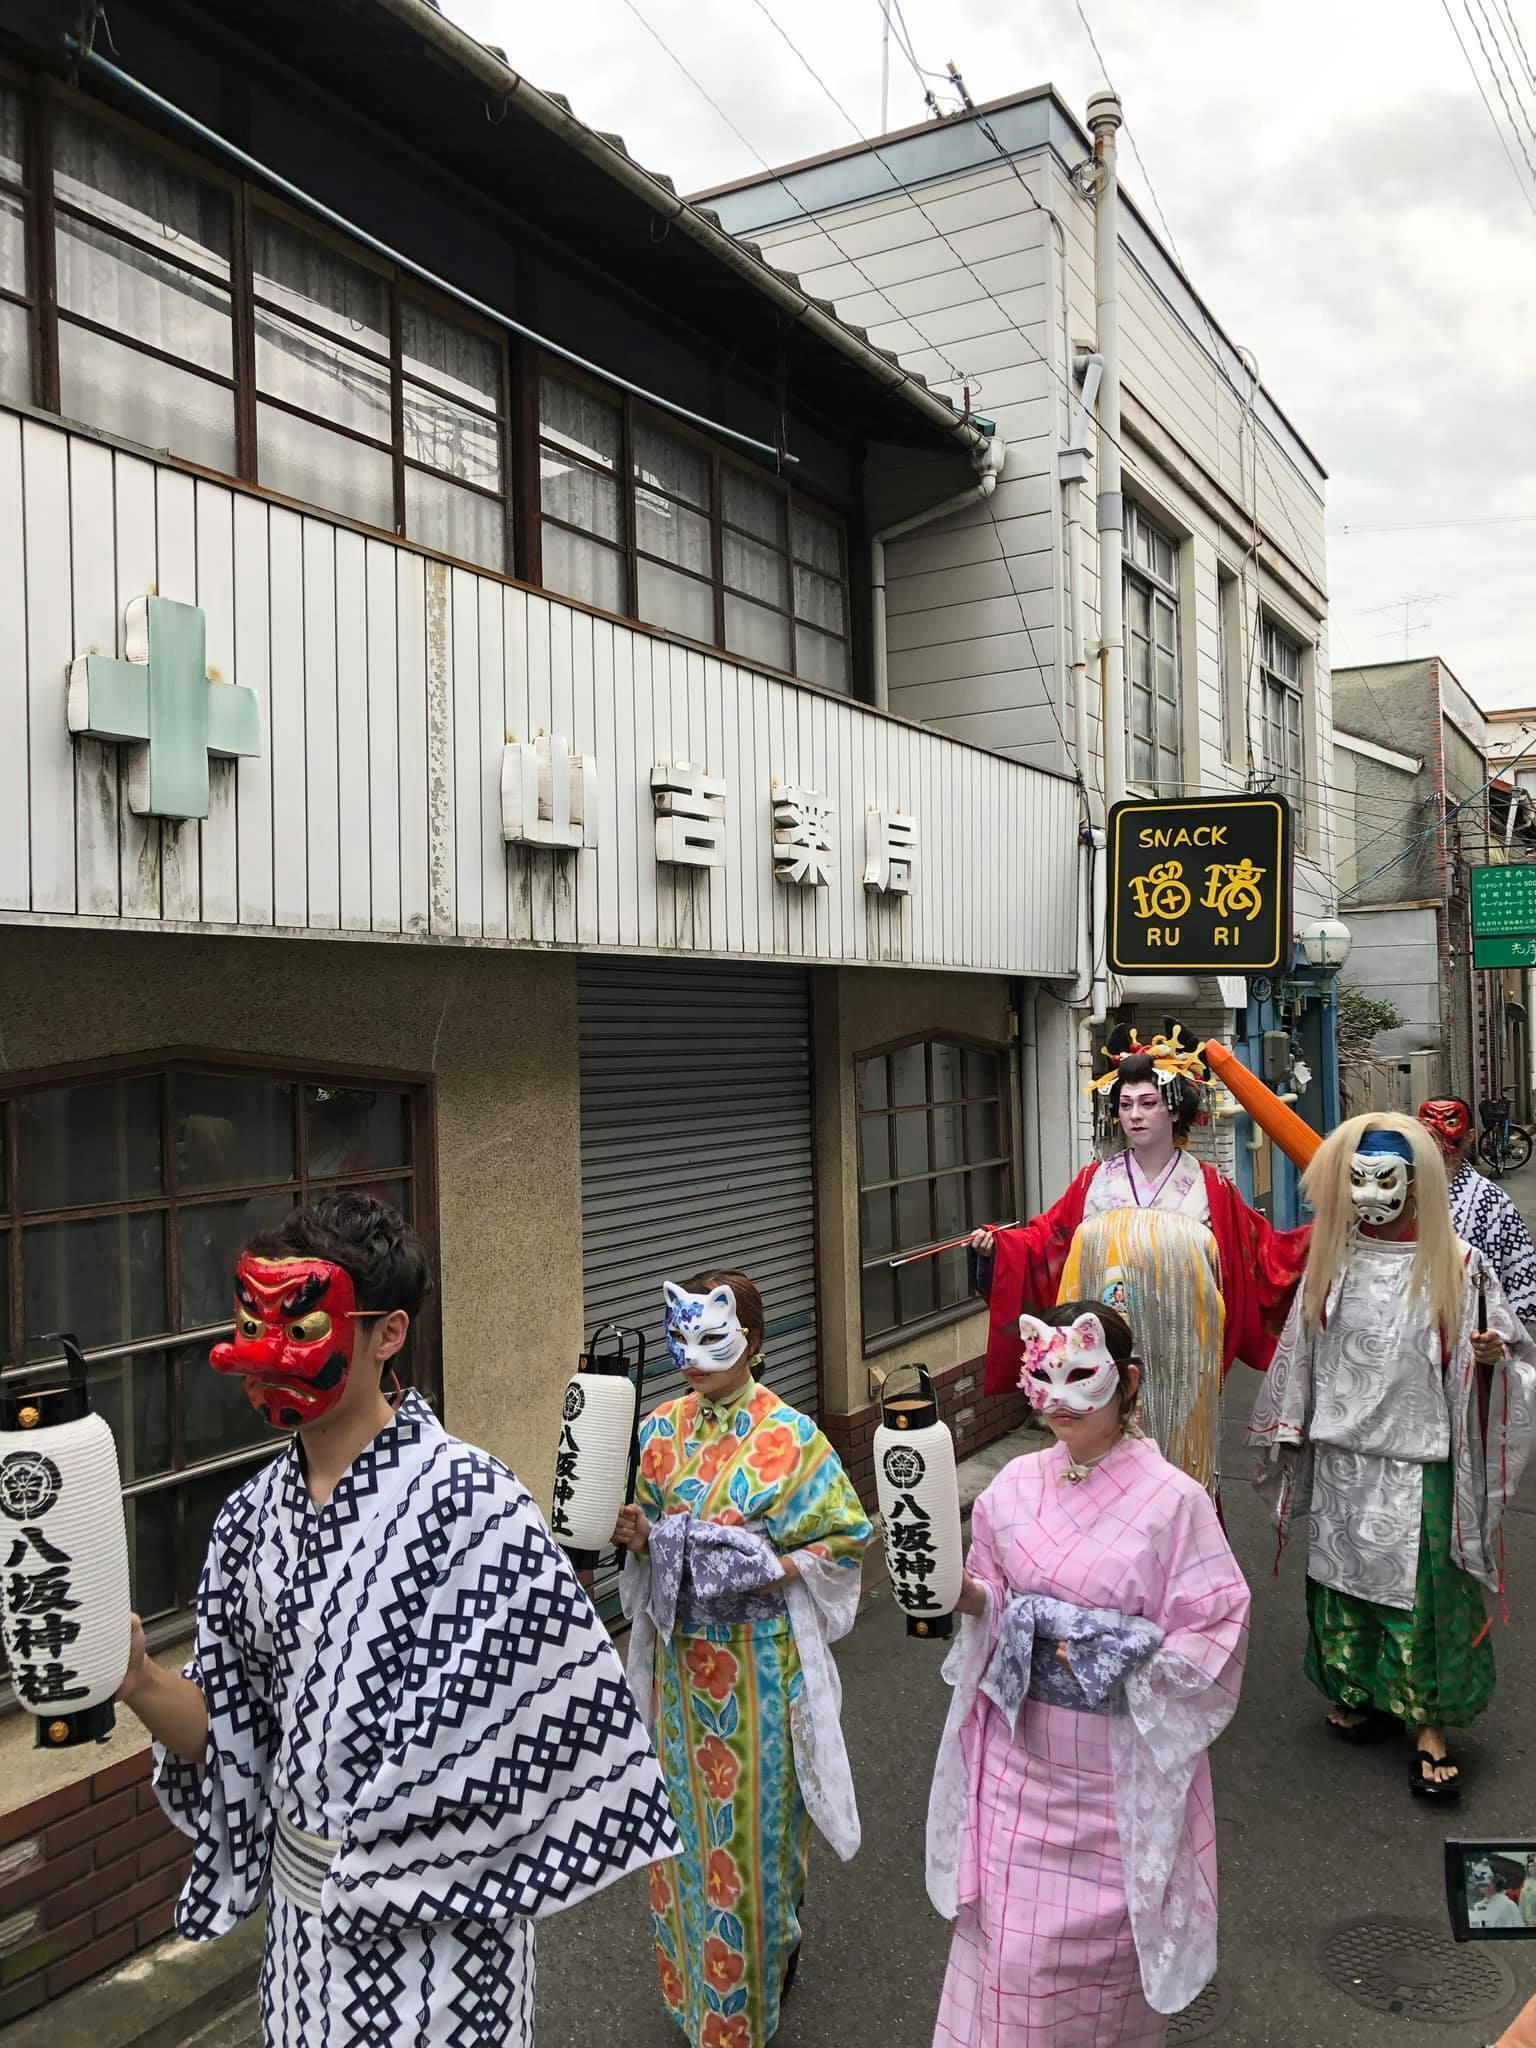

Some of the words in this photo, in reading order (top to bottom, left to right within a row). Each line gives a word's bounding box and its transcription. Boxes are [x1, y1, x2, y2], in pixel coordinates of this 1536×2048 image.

[1138, 826, 1228, 849] SNACK
[1147, 927, 1180, 946] RU
[1214, 927, 1240, 946] RI
[889, 1493, 943, 1611] 八坂神社
[3, 1526, 91, 1706] 八坂神社
